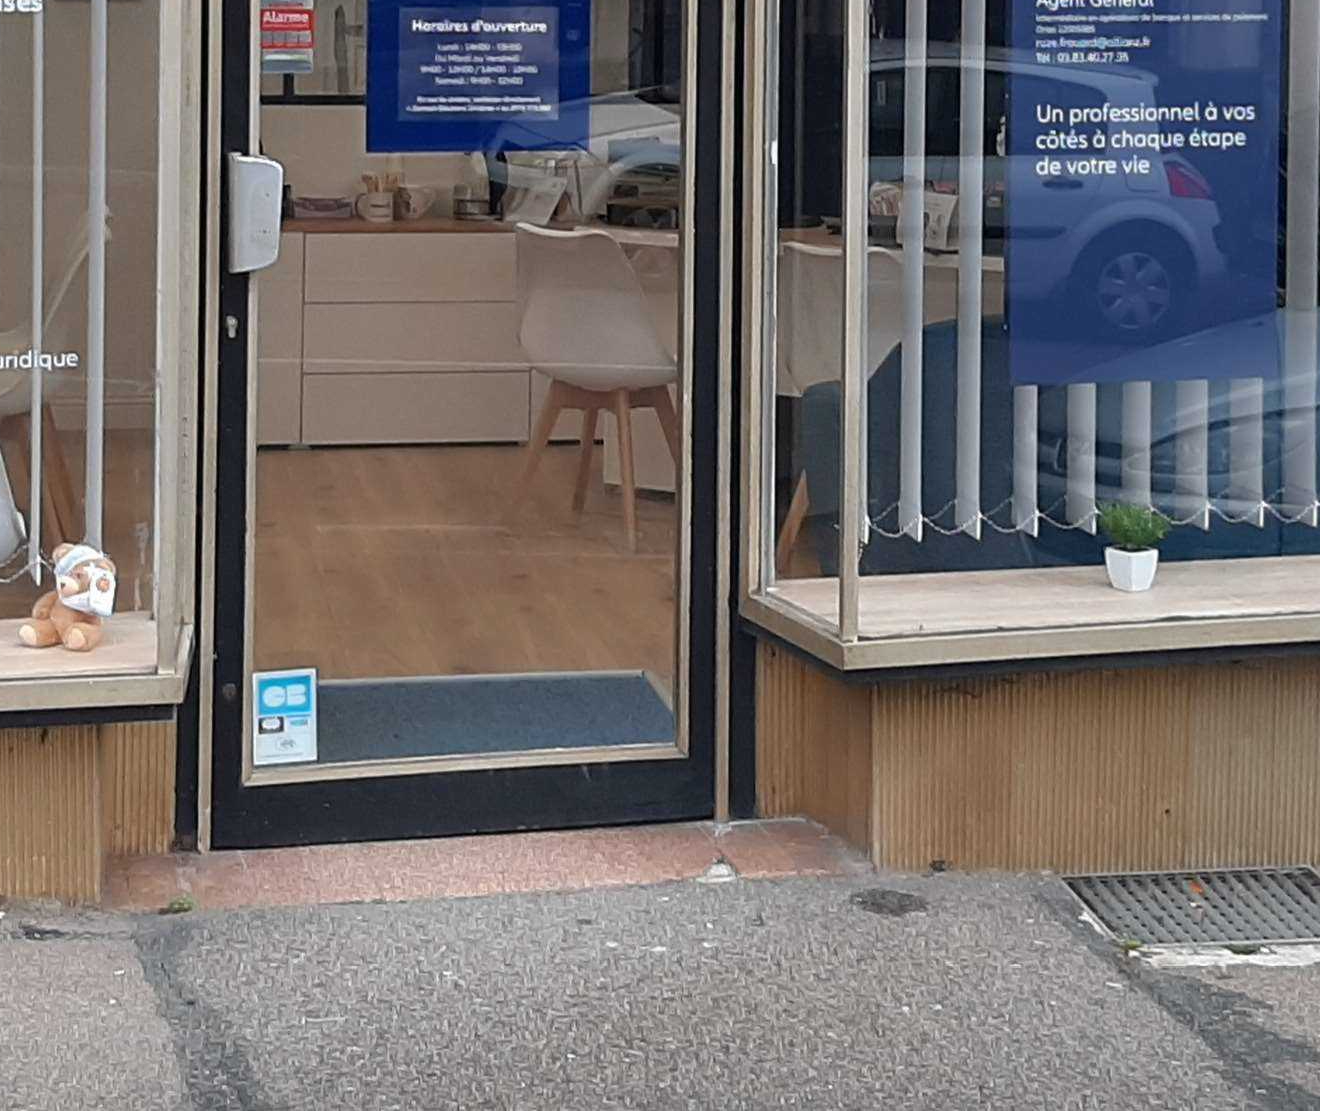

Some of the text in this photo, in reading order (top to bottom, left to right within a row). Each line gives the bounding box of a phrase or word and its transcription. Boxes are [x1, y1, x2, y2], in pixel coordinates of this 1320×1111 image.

[411, 18, 548, 34] Horaires d'ouverture
[1036, 100, 1257, 127] Un professionnel à vos
[1035, 128, 1247, 153] côtés à chaque étape
[1035, 154, 1151, 176] de votre vie
